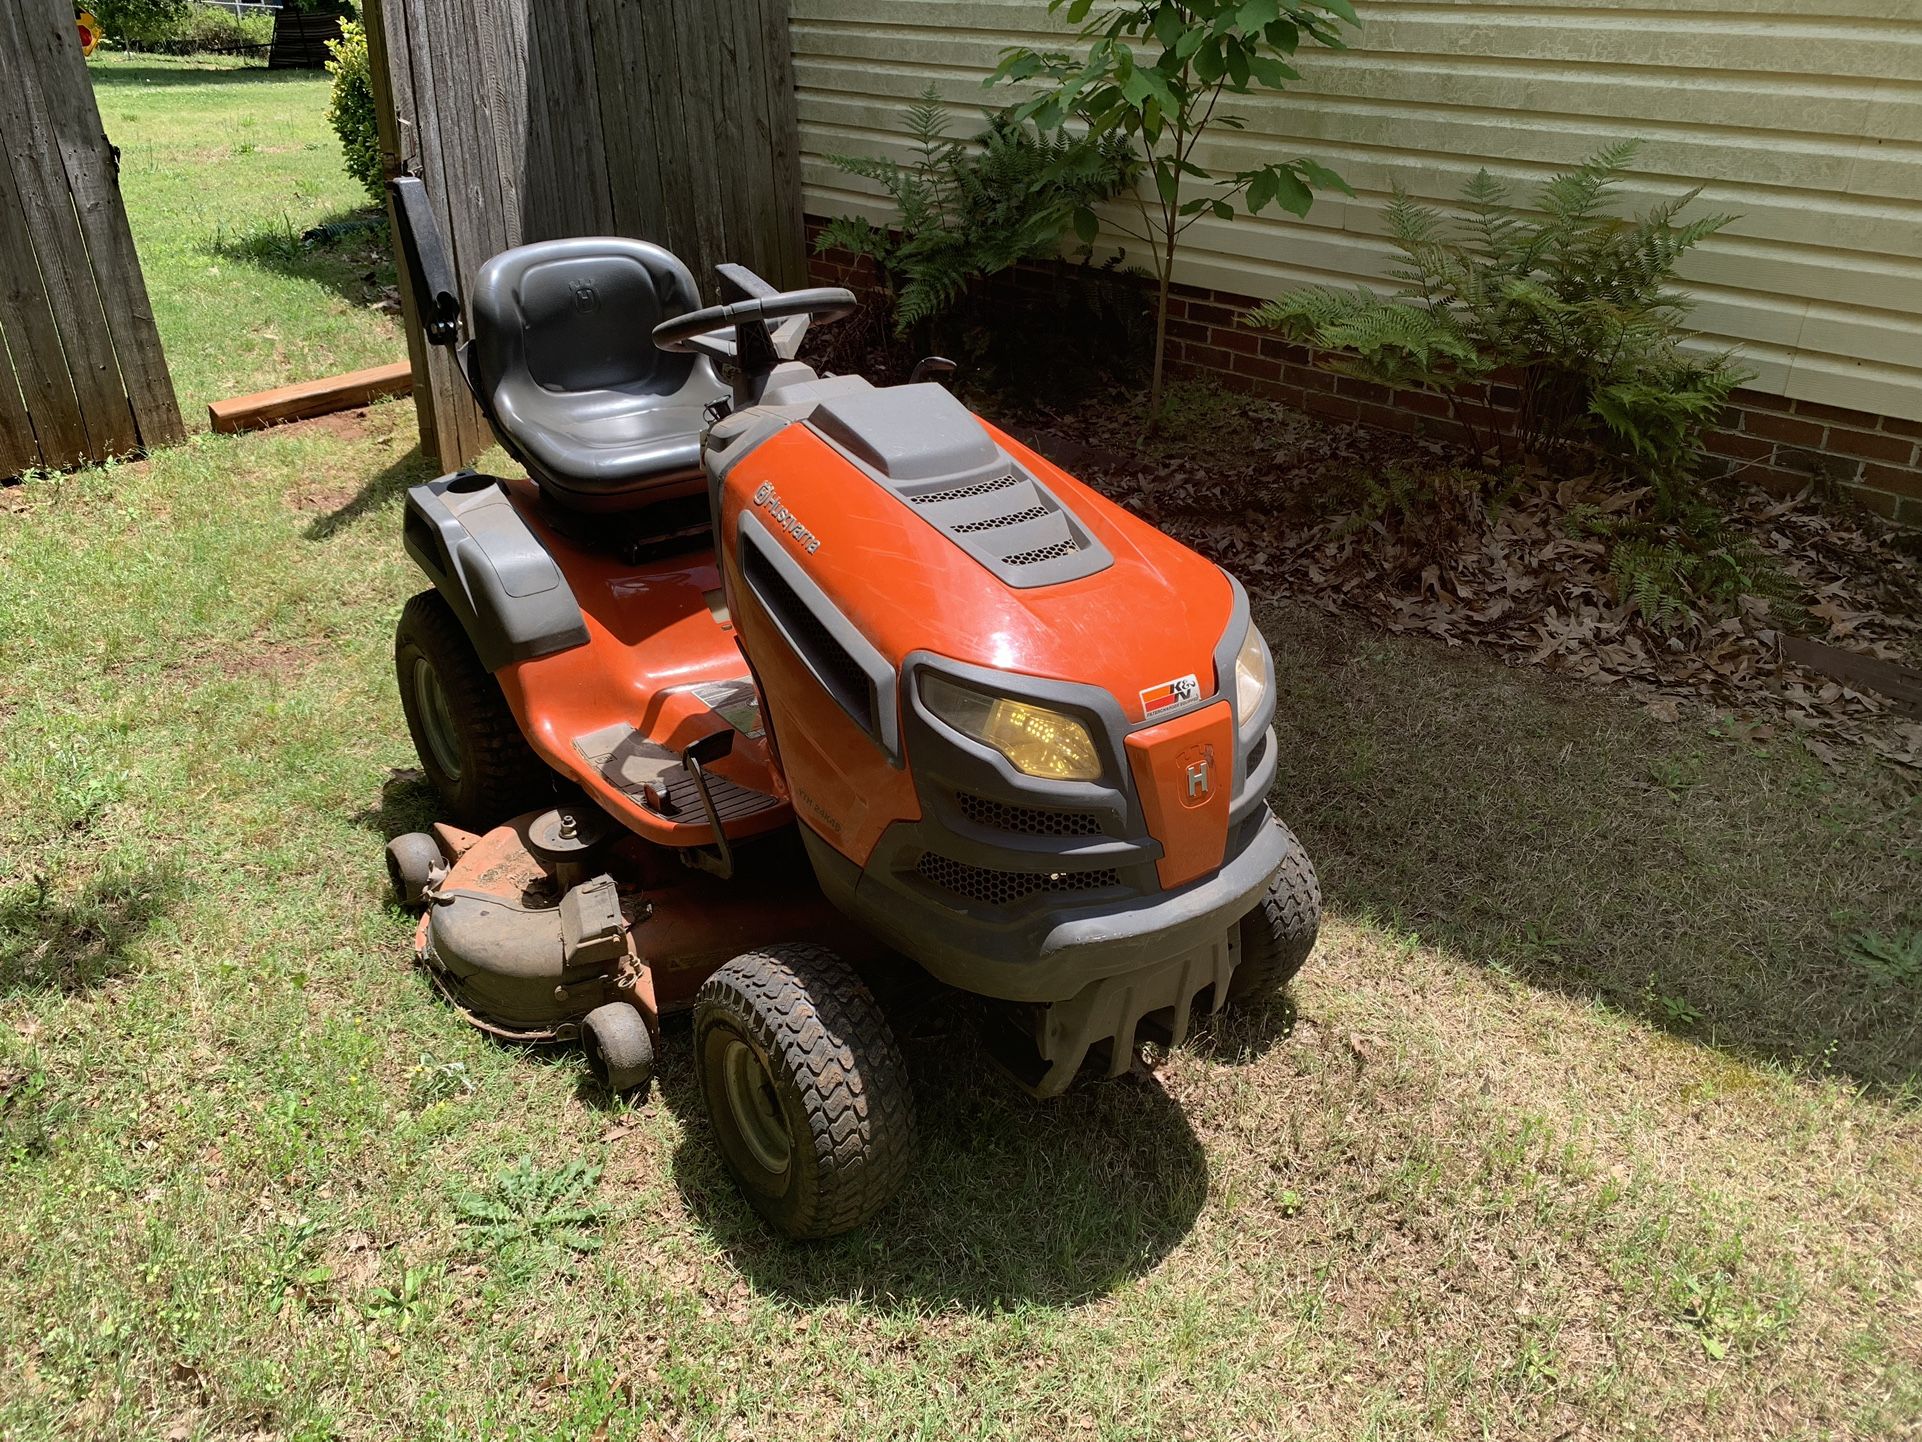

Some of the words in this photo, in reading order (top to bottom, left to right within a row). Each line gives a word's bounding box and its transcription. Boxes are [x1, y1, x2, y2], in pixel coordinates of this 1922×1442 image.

[763, 490, 821, 556] Husqvarna
[1169, 679, 1196, 703] K&N
[1187, 762, 1208, 798] H
